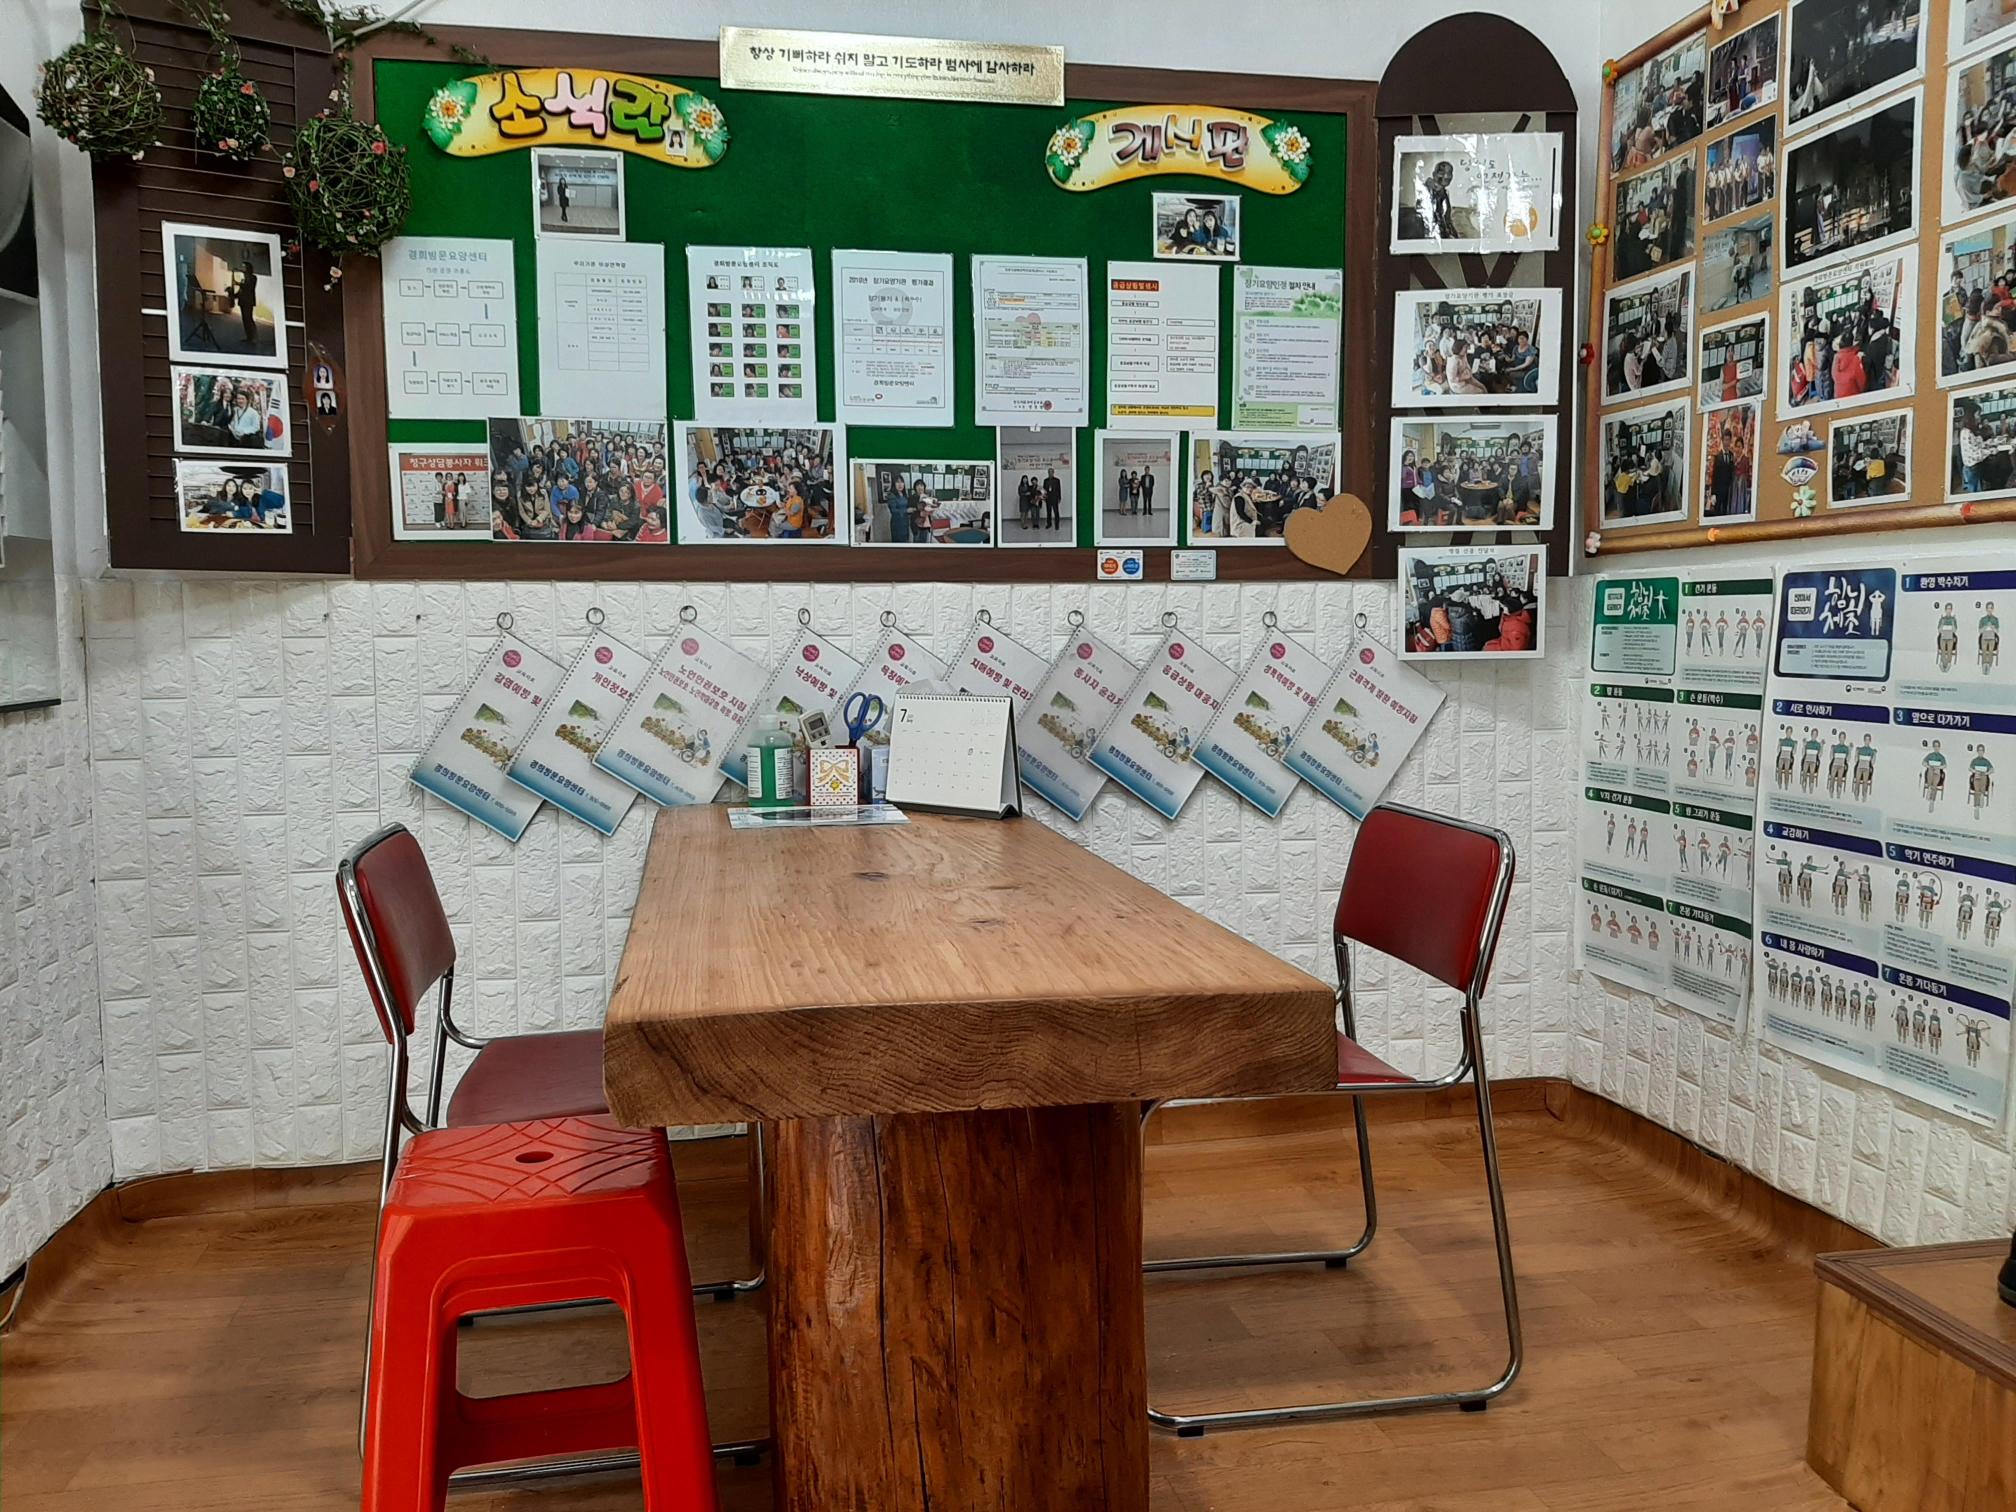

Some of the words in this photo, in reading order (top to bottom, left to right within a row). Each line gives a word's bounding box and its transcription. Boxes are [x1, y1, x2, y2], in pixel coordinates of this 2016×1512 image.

[749, 46, 775, 61] 항상
[779, 48, 830, 63] 기뻐하라
[834, 51, 858, 66] 쉬지
[863, 53, 889, 67] 말고
[892, 56, 942, 70] 기도하라
[946, 58, 982, 73] 범사에
[986, 60, 1035, 76] 감사하라
[489, 71, 672, 144] 소식란
[1109, 113, 1249, 172] 게시판
[408, 249, 488, 262] 경희방문요양센터
[1905, 577, 1910, 589] 1
[494, 671, 531, 700] 감염예방
[794, 665, 831, 695] 낙상예방
[1594, 686, 1600, 694] 2
[1679, 692, 1684, 701] 3
[1194, 688, 1222, 711] 대응지
[900, 708, 908, 723] 7
[1776, 702, 1783, 712] 2
[1805, 705, 1832, 717] 인사하기
[1897, 711, 1903, 721] 3
[1937, 714, 1970, 727] 다가가기
[1675, 804, 1680, 812] 5
[1767, 824, 1774, 834] 4
[1889, 846, 1896, 857] 5
[1765, 934, 1772, 945] 6
[1884, 967, 1890, 979] 7
